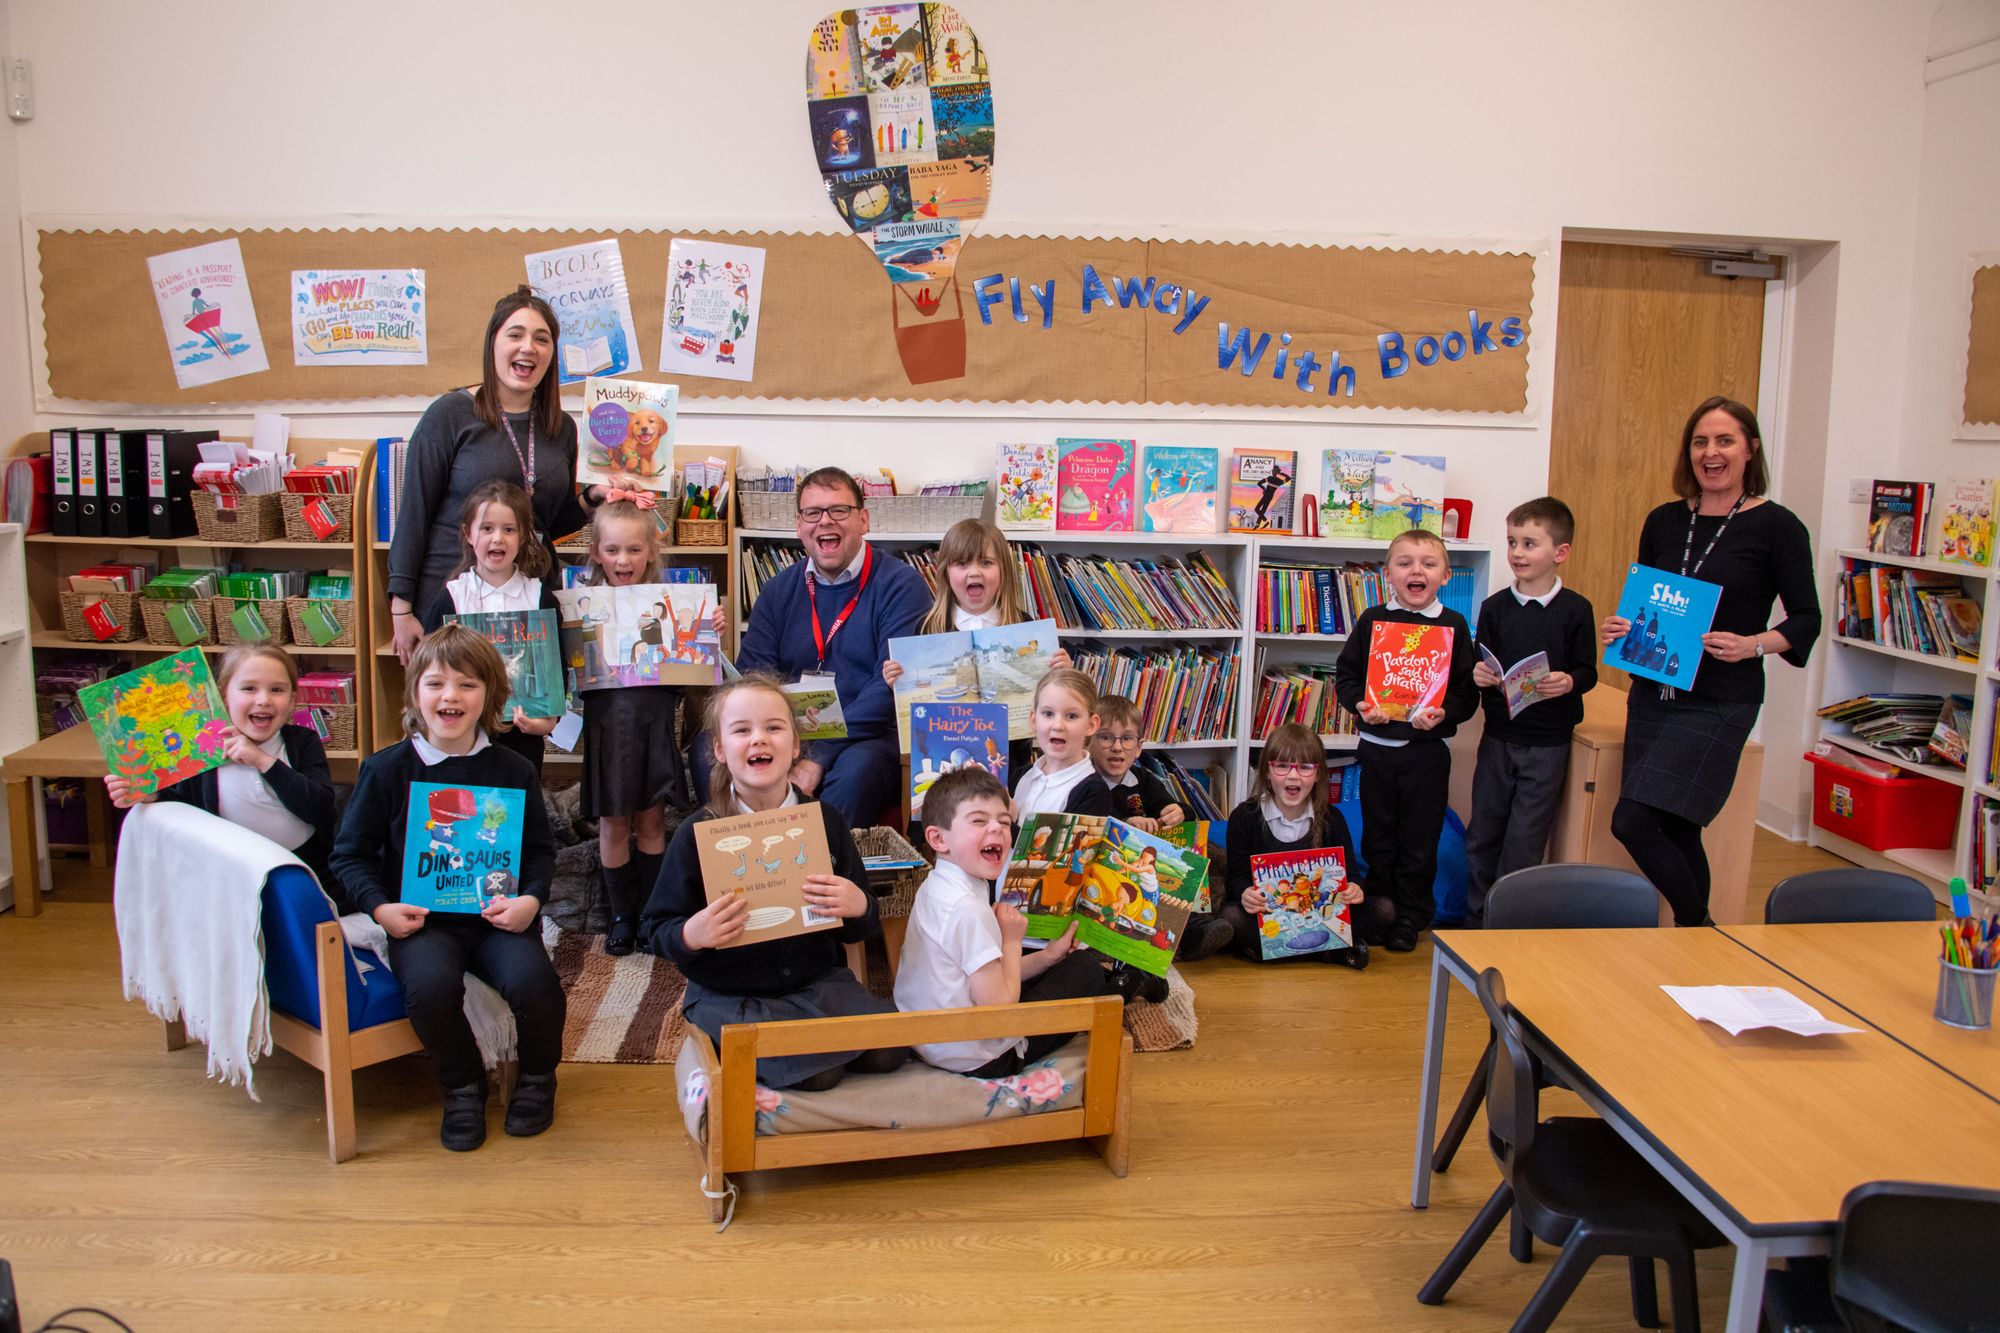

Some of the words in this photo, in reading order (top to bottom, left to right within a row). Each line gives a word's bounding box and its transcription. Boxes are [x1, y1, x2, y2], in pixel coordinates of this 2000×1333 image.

[941, 13, 962, 24] Last
[941, 23, 965, 34] Wolf
[832, 167, 898, 184] TUESDAY
[910, 167, 932, 175] BABA
[935, 163, 958, 171] YAGA
[890, 225, 915, 239] STORM
[916, 221, 944, 237] WHALE
[540, 250, 604, 280] BOOKS
[312, 277, 366, 307] WOW!
[339, 299, 375, 312] PLACES
[376, 300, 389, 309] you
[306, 317, 326, 336] GO
[387, 311, 408, 323] you
[331, 326, 354, 341] BE
[376, 320, 415, 341] Read!
[973, 273, 1055, 329] Fly
[1082, 264, 1211, 335] Away
[1218, 321, 1356, 397] With
[1377, 308, 1526, 379] Books
[590, 417, 627, 428] Birthday
[598, 428, 622, 438] Party
[1003, 445, 1033, 461] Dancing
[56, 451, 69, 474] RWI
[81, 451, 92, 476] RWI
[108, 451, 119, 475] RWI
[150, 453, 161, 477] RWI
[1018, 458, 1048, 470] Through
[1071, 462, 1109, 478] Dragon
[1243, 458, 1273, 469] ANANCY
[1955, 490, 1984, 502] Castles
[1887, 502, 1912, 513] MOON
[1650, 582, 1690, 609] Shh!
[1322, 586, 1332, 624] Dictionary
[512, 619, 547, 641] Red
[1382, 671, 1428, 693] giraffe
[1398, 666, 1422, 680] said
[1423, 666, 1441, 681] the
[807, 692, 832, 700] Lunch
[948, 705, 974, 717] The
[929, 717, 970, 734] Hairy
[970, 717, 997, 731] Toe
[738, 821, 752, 830] book
[1256, 858, 1307, 882] PIRATE
[1307, 852, 1340, 872] POOL
[435, 873, 475, 891] UNITED
[755, 881, 766, 889] him
[766, 878, 787, 888] drive?
